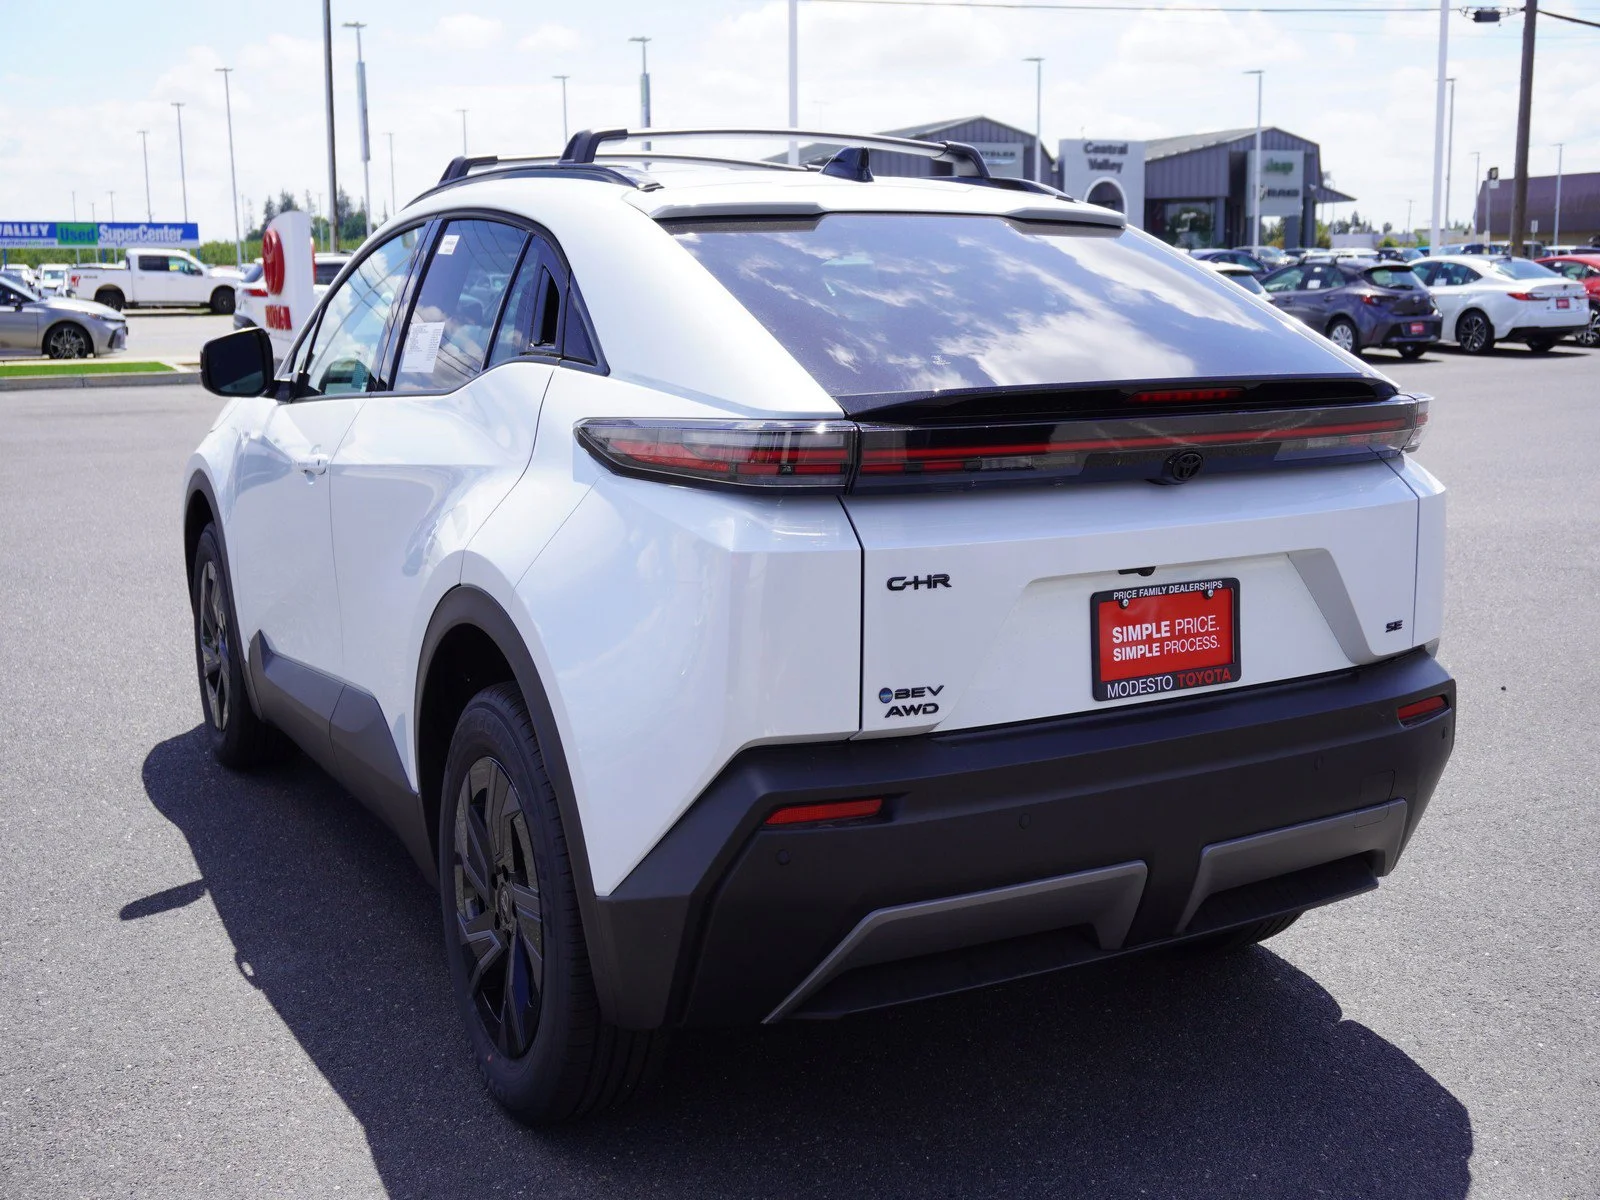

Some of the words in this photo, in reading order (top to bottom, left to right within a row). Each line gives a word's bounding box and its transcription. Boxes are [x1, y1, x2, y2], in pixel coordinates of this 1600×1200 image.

[1083, 141, 1128, 155] Central
[1088, 158, 1123, 174] Valley
[60, 227, 96, 241] Used
[99, 224, 184, 246] SuperCenter
[887, 574, 952, 591] C-HR
[1113, 590, 1137, 600] PRICE
[1139, 586, 1167, 598] FAMILY
[1169, 580, 1223, 594] DEALERSHIPS
[1112, 621, 1171, 644] SIMPLE
[1175, 615, 1220, 636] PRICE.
[1385, 620, 1403, 633] SE
[1113, 643, 1160, 662] SIMPLE
[1164, 635, 1221, 655] PROCESS.
[1107, 675, 1173, 698] MODESTO
[1177, 668, 1232, 688] TOYOTA
[894, 685, 945, 700] BEV
[884, 702, 940, 718] AWD
